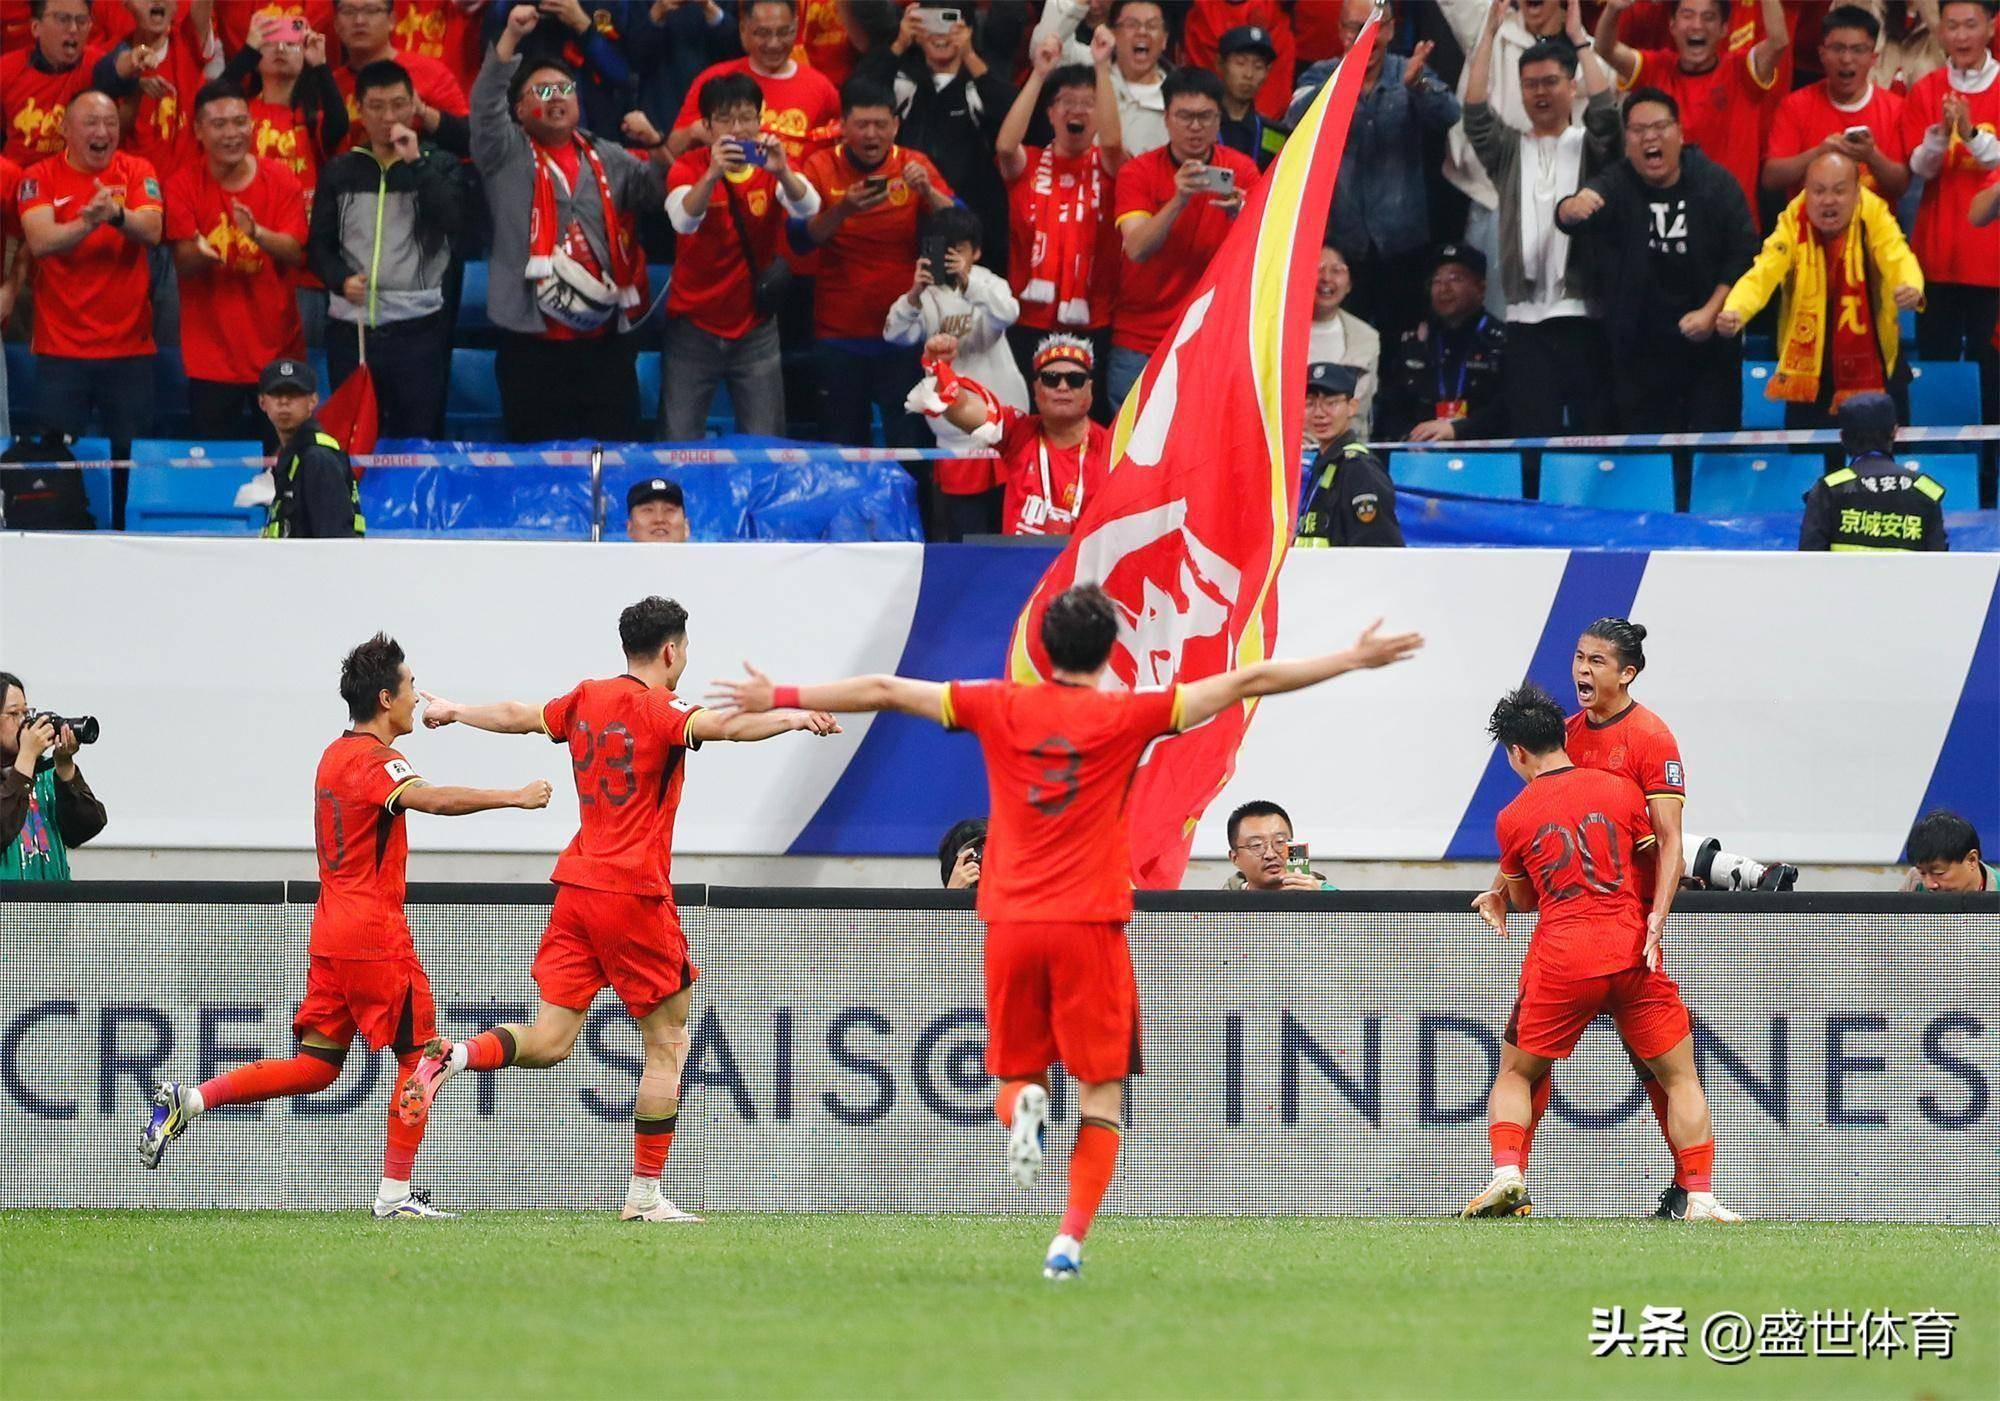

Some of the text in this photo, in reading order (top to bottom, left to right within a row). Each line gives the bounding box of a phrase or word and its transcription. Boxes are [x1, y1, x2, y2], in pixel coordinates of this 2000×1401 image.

[1839, 508, 1924, 541] 京城安保
[573, 720, 637, 806] 23
[1027, 733, 1082, 816] 3
[1532, 811, 1624, 901] 20
